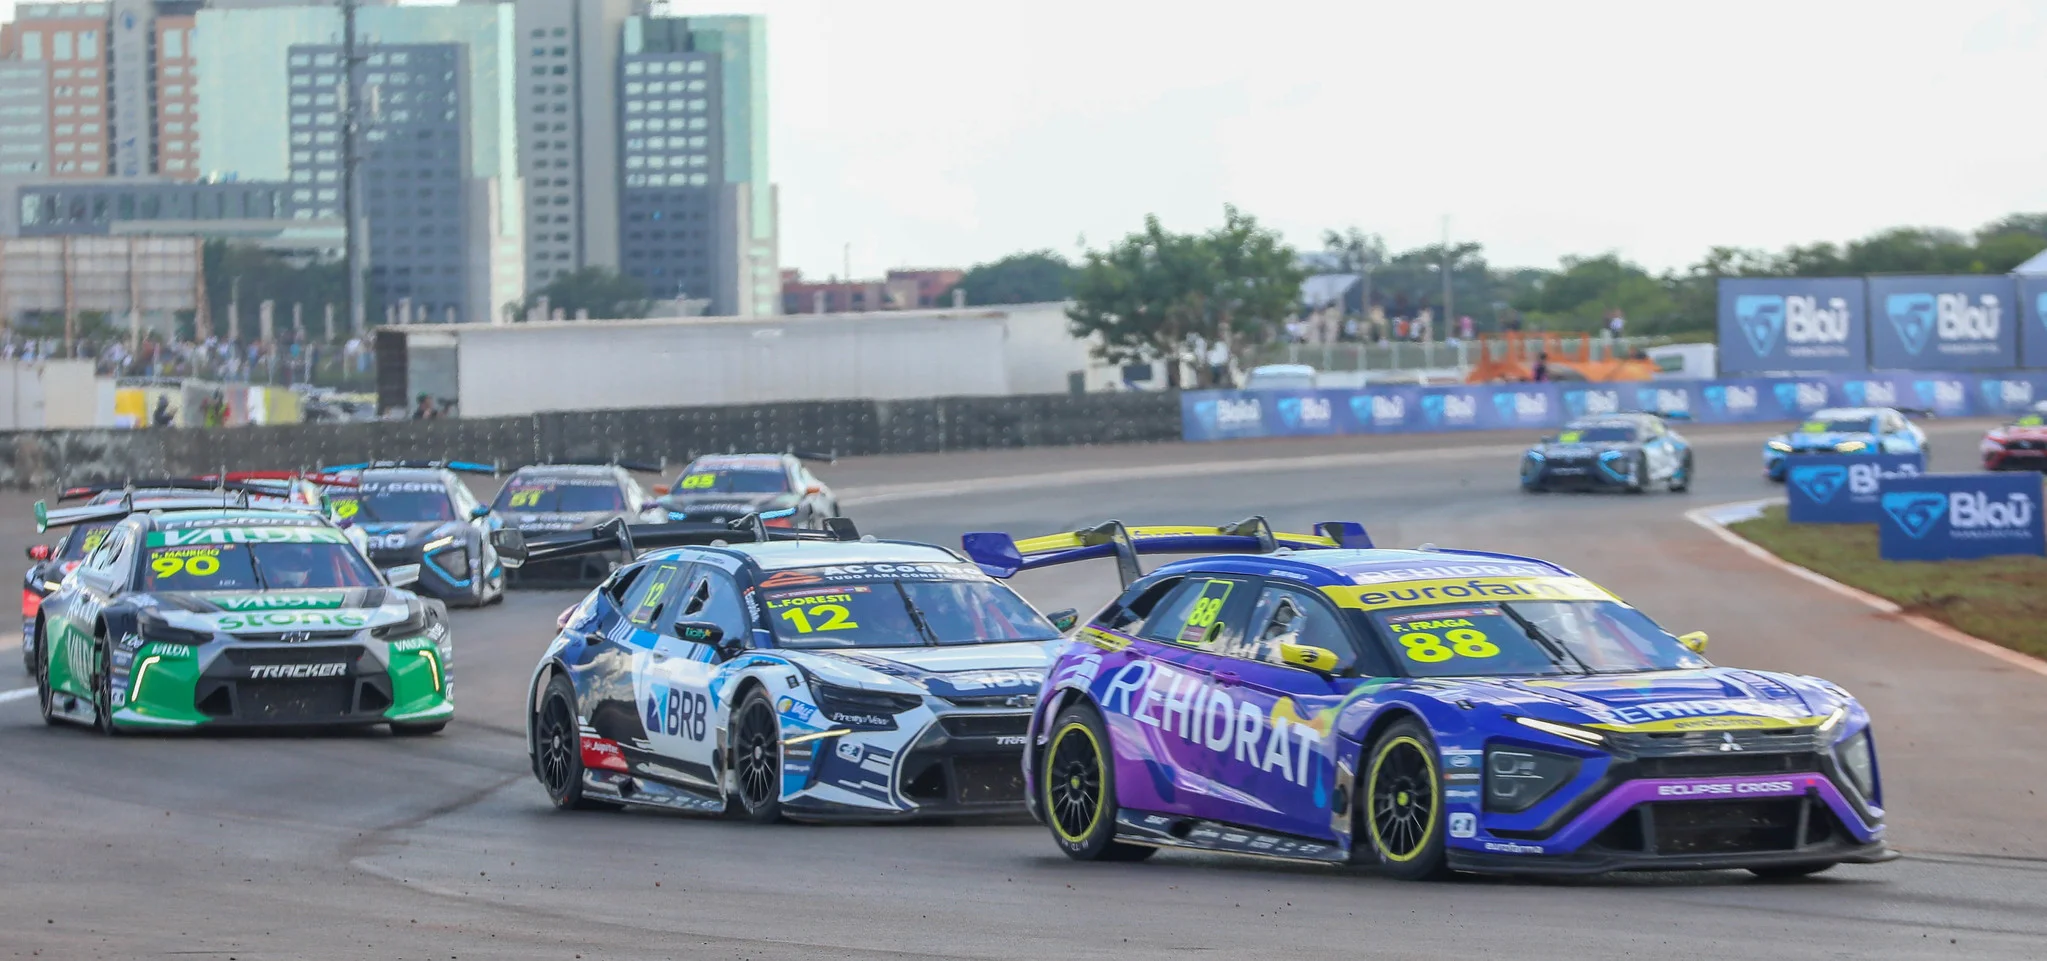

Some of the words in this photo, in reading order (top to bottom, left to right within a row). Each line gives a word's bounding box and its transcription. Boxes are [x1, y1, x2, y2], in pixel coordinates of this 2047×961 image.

[151, 556, 220, 579] 90
[823, 565, 867, 576] AC
[1359, 565, 1548, 583] REHIDRAT
[781, 604, 859, 634] 12
[1187, 597, 1222, 627] 88
[1390, 623, 1409, 633] F.
[1410, 618, 1475, 630] FRAGA
[1398, 628, 1501, 663] 88
[249, 662, 347, 679] TRACKER
[667, 687, 707, 742] BRB
[1102, 659, 1321, 787] REHIDRAT
[1658, 783, 1733, 796] ECLIPSE
[1736, 781, 1793, 794] CROSS
